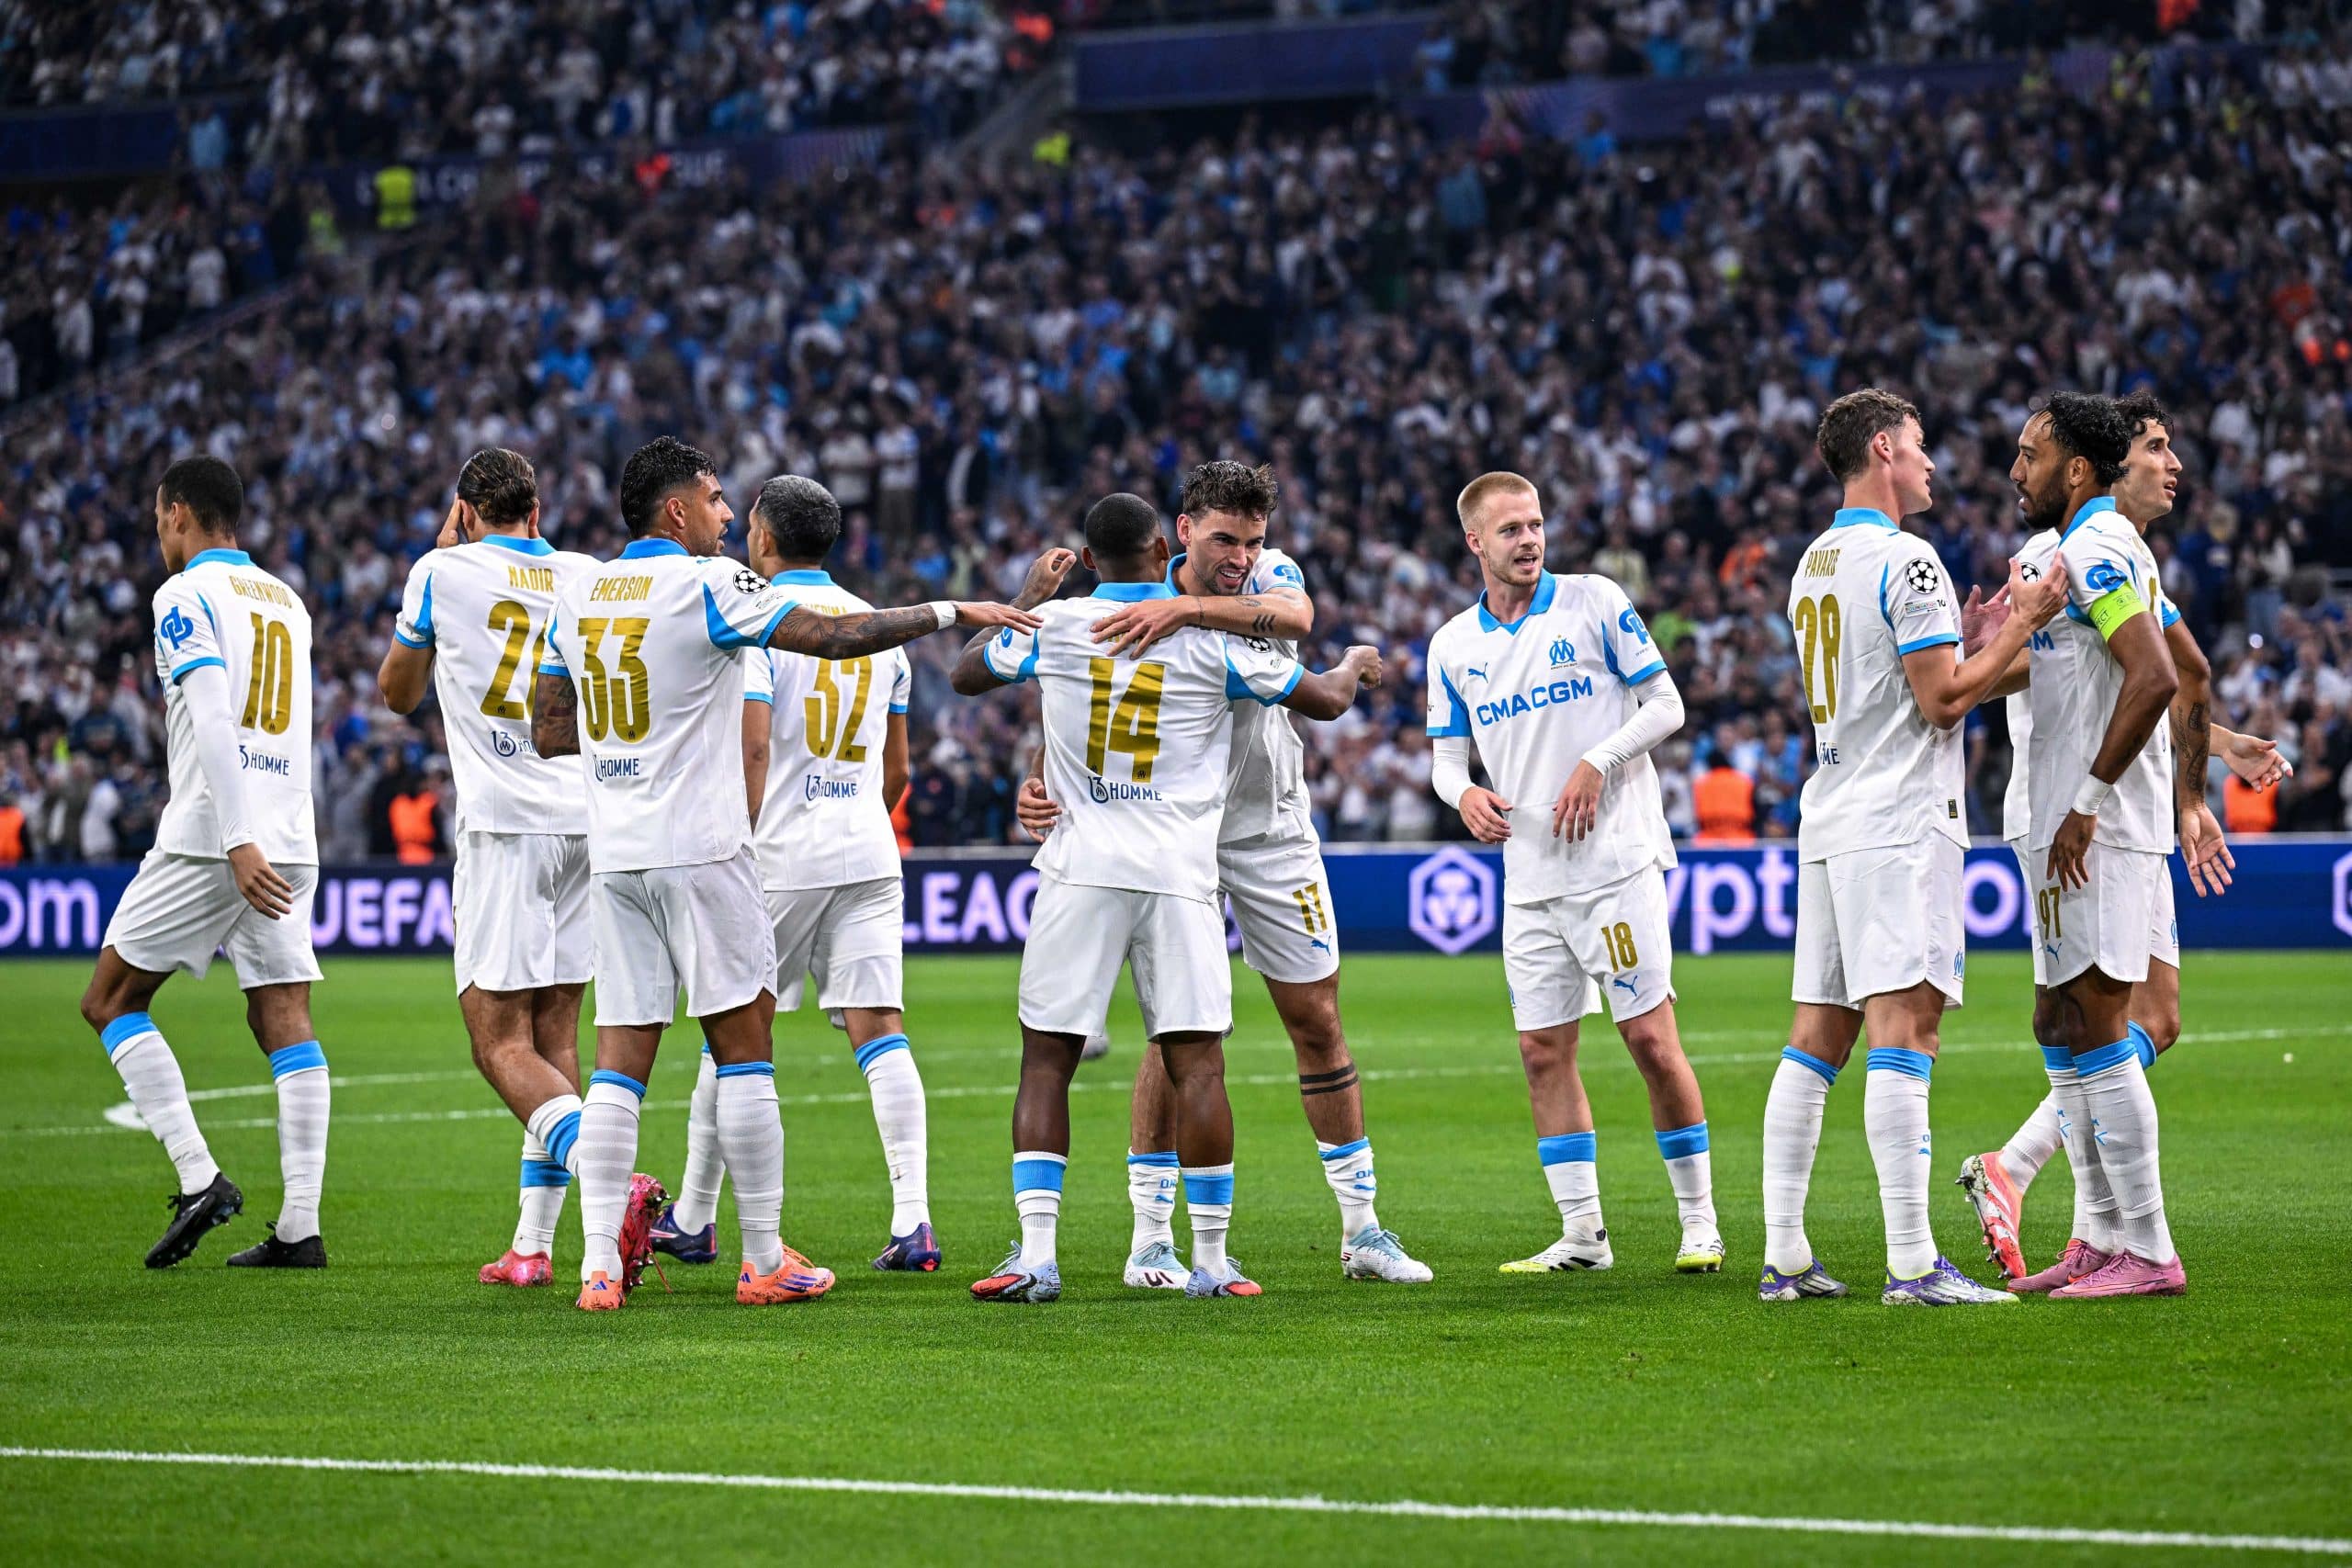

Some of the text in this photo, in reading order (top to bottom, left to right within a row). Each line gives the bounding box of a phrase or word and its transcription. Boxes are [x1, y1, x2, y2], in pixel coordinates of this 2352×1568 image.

[508, 566, 554, 592] NADIR
[590, 576, 653, 602] EMERSON
[241, 612, 293, 735] 10
[578, 617, 650, 744] 33
[1795, 593, 1841, 724] 28
[804, 654, 872, 762] 32
[1086, 657, 1166, 784] 14
[251, 753, 289, 776] HOMME
[600, 758, 639, 778] HOMME
[1110, 782, 1162, 801] HOMME
[1292, 882, 1328, 933] 17
[2039, 886, 2061, 941] 97
[1600, 921, 1638, 974] 18
